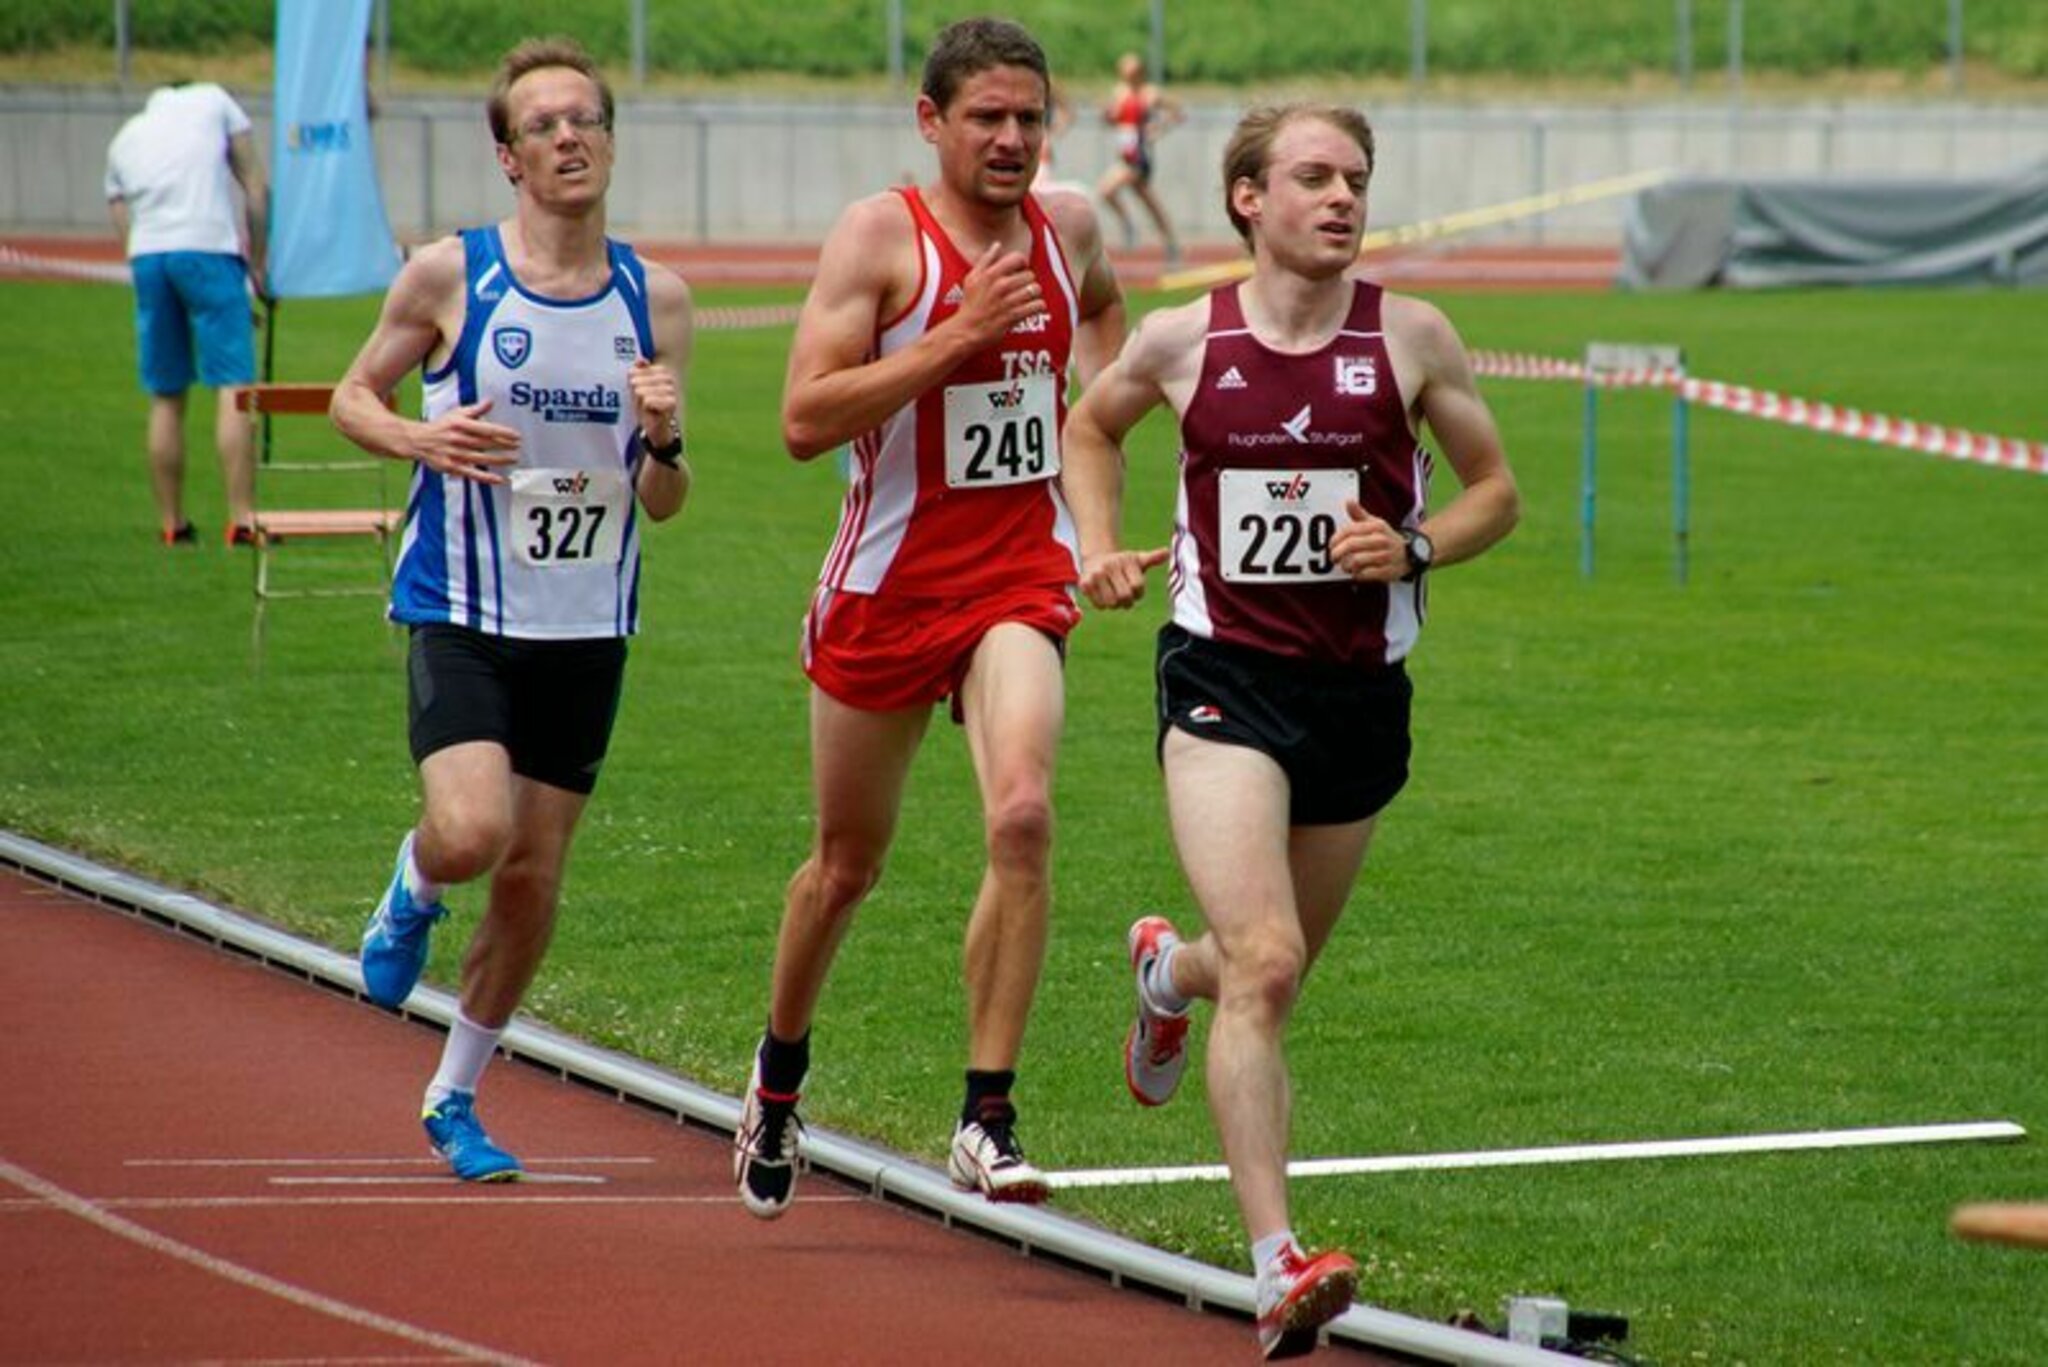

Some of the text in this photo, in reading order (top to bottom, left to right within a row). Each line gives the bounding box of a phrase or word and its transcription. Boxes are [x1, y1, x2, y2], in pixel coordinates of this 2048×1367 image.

[510, 381, 620, 412] Sparda
[964, 416, 1044, 481] 249
[528, 504, 607, 561] 327
[1238, 514, 1336, 575] 229
